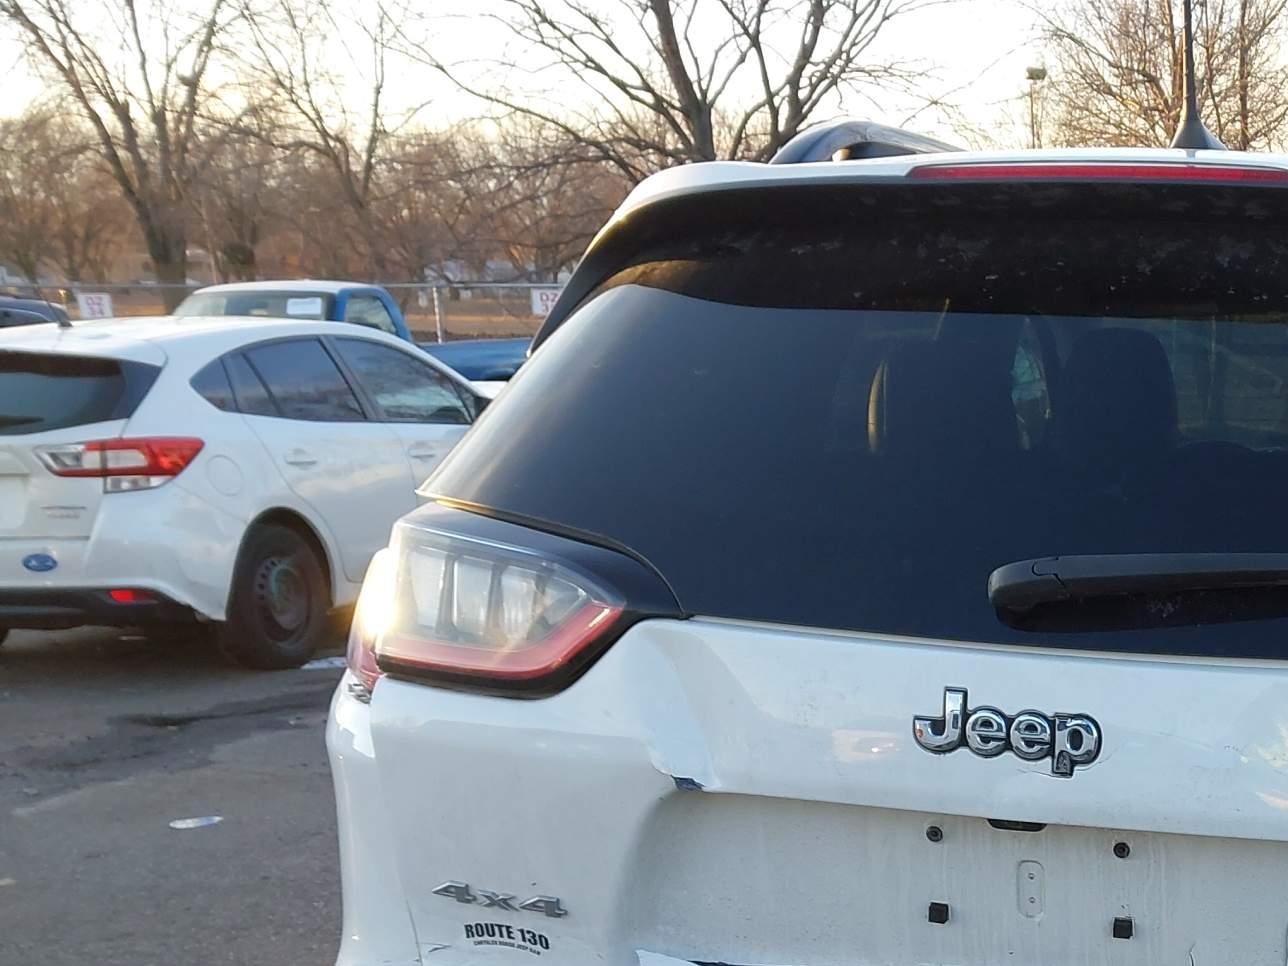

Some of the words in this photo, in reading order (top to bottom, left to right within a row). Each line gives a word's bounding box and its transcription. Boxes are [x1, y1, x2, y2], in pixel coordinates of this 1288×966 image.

[540, 292, 559, 302] DZ
[913, 686, 1102, 777] Jeep
[431, 880, 568, 918] 4x4
[464, 923, 516, 940] ROUTE
[517, 928, 550, 950] 130
